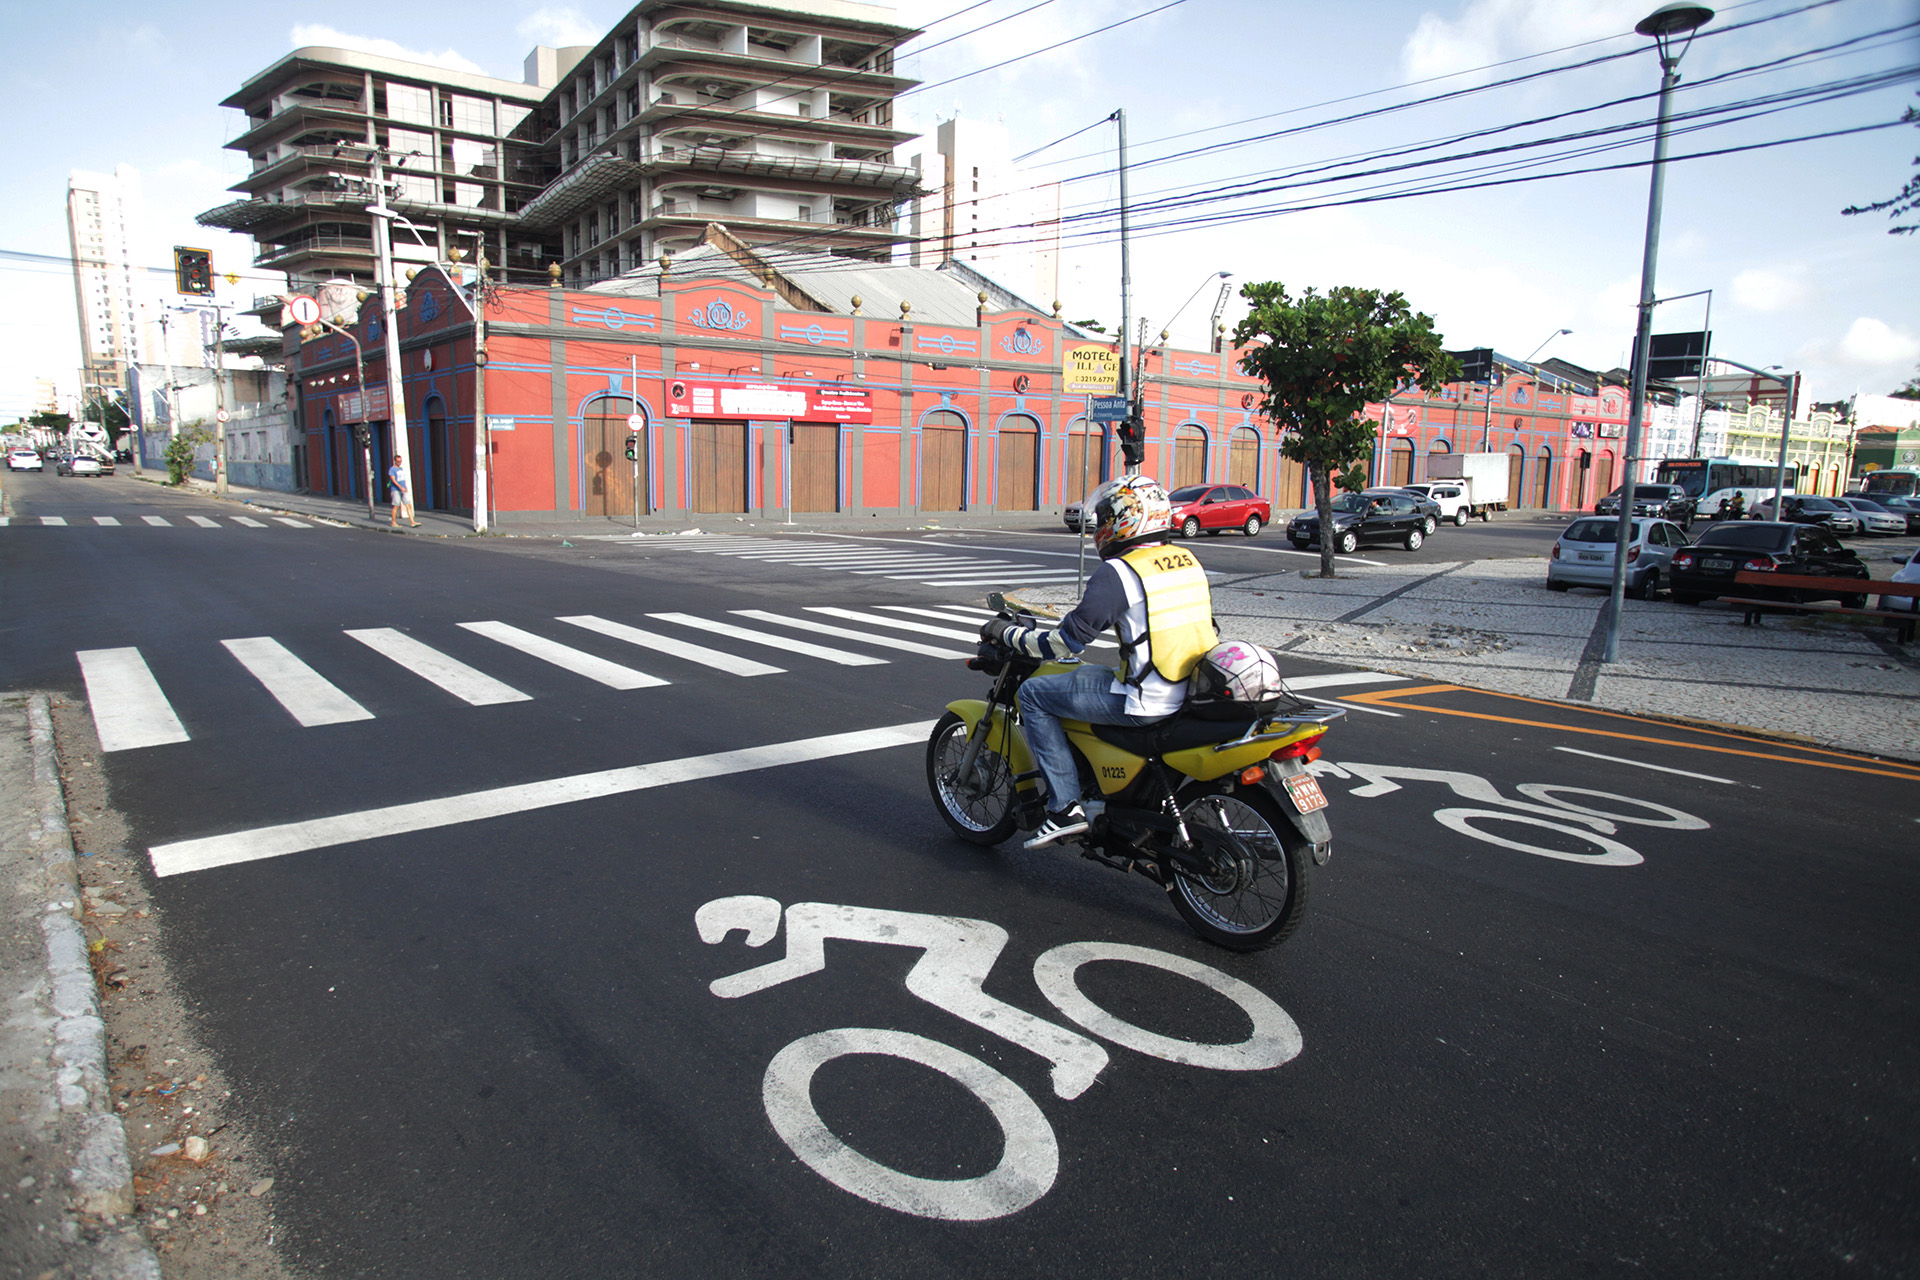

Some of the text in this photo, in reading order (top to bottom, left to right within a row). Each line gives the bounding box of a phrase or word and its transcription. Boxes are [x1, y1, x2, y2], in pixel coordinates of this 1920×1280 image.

[1072, 351, 1112, 361] MOTEL
[1094, 400, 1126, 409] Pessoa Anta
[1153, 554, 1193, 571] 1225
[1101, 766, 1126, 778] 01225
[1293, 781, 1318, 799] HWM
[1298, 793, 1325, 811] 9173
